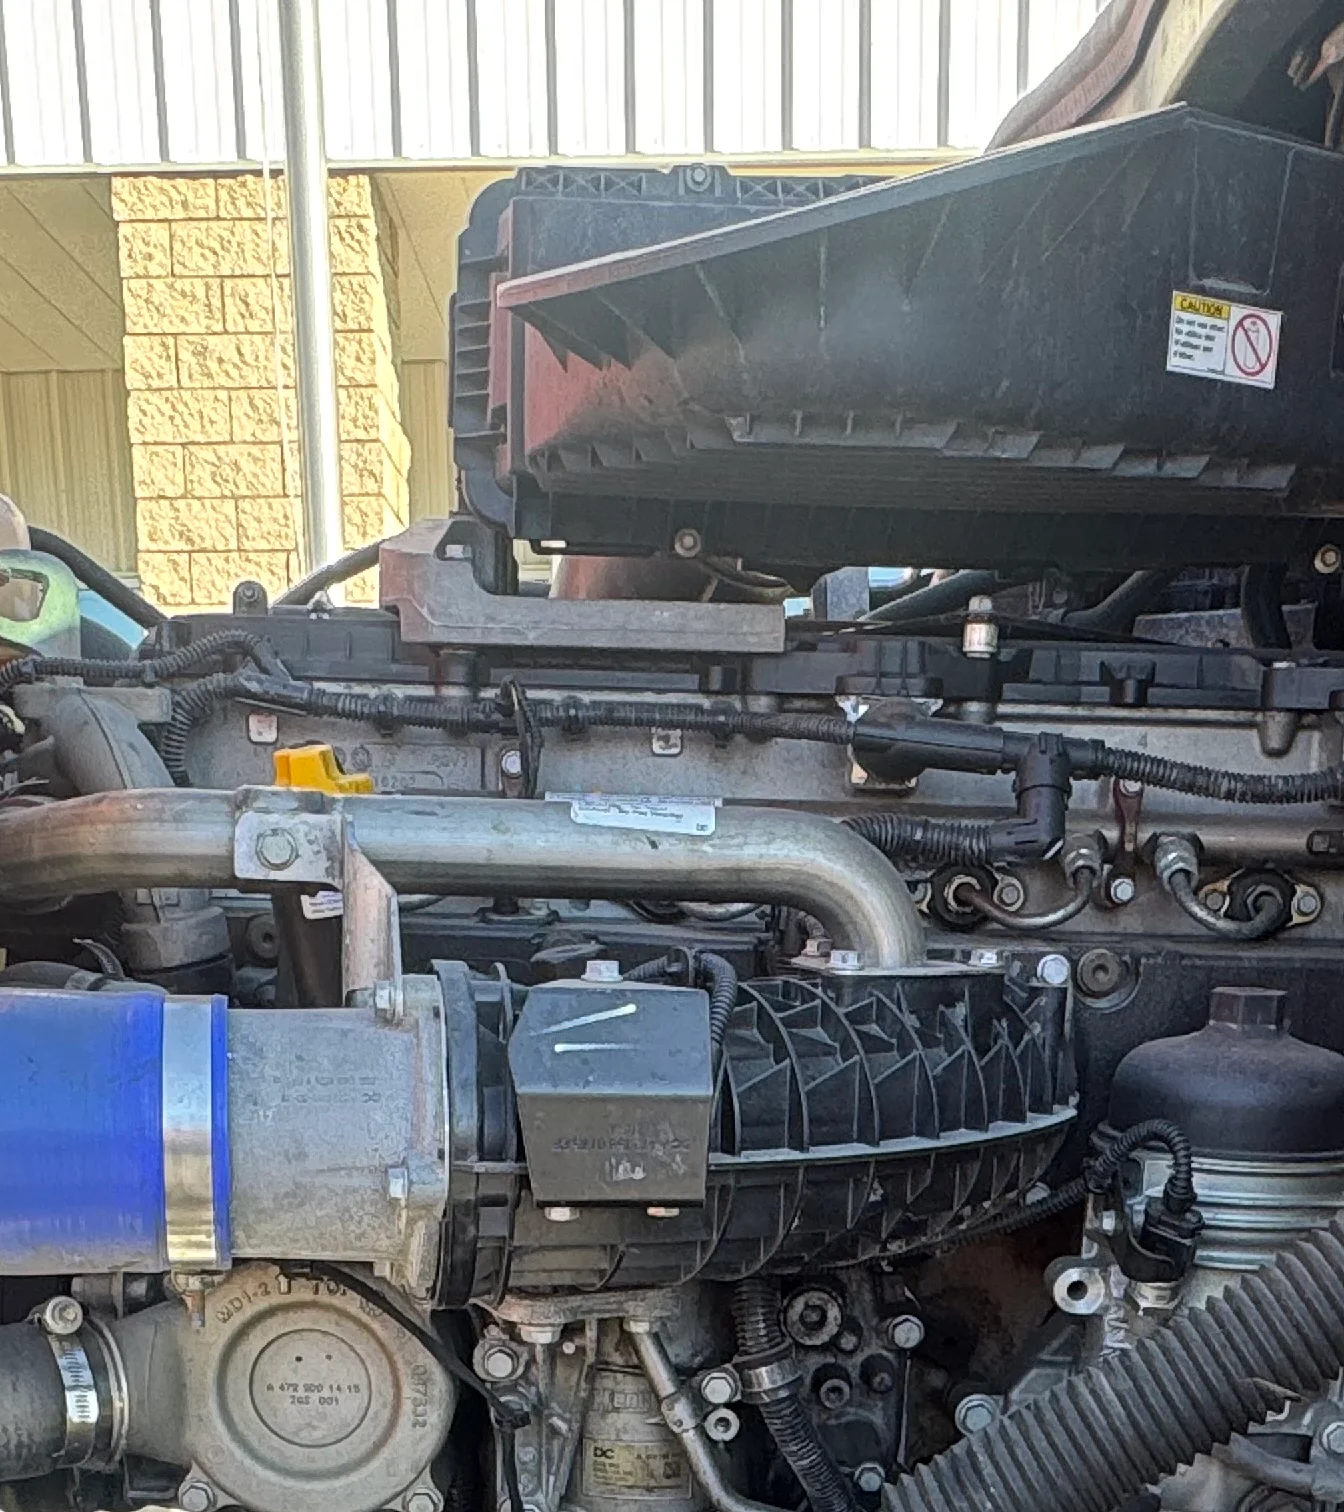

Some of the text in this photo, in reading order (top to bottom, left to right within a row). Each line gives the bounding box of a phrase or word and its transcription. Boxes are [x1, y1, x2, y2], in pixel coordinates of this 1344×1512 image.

[1180, 298, 1224, 315] CAUTION
[312, 1275, 348, 1296] TO
[593, 1446, 615, 1460] DC
